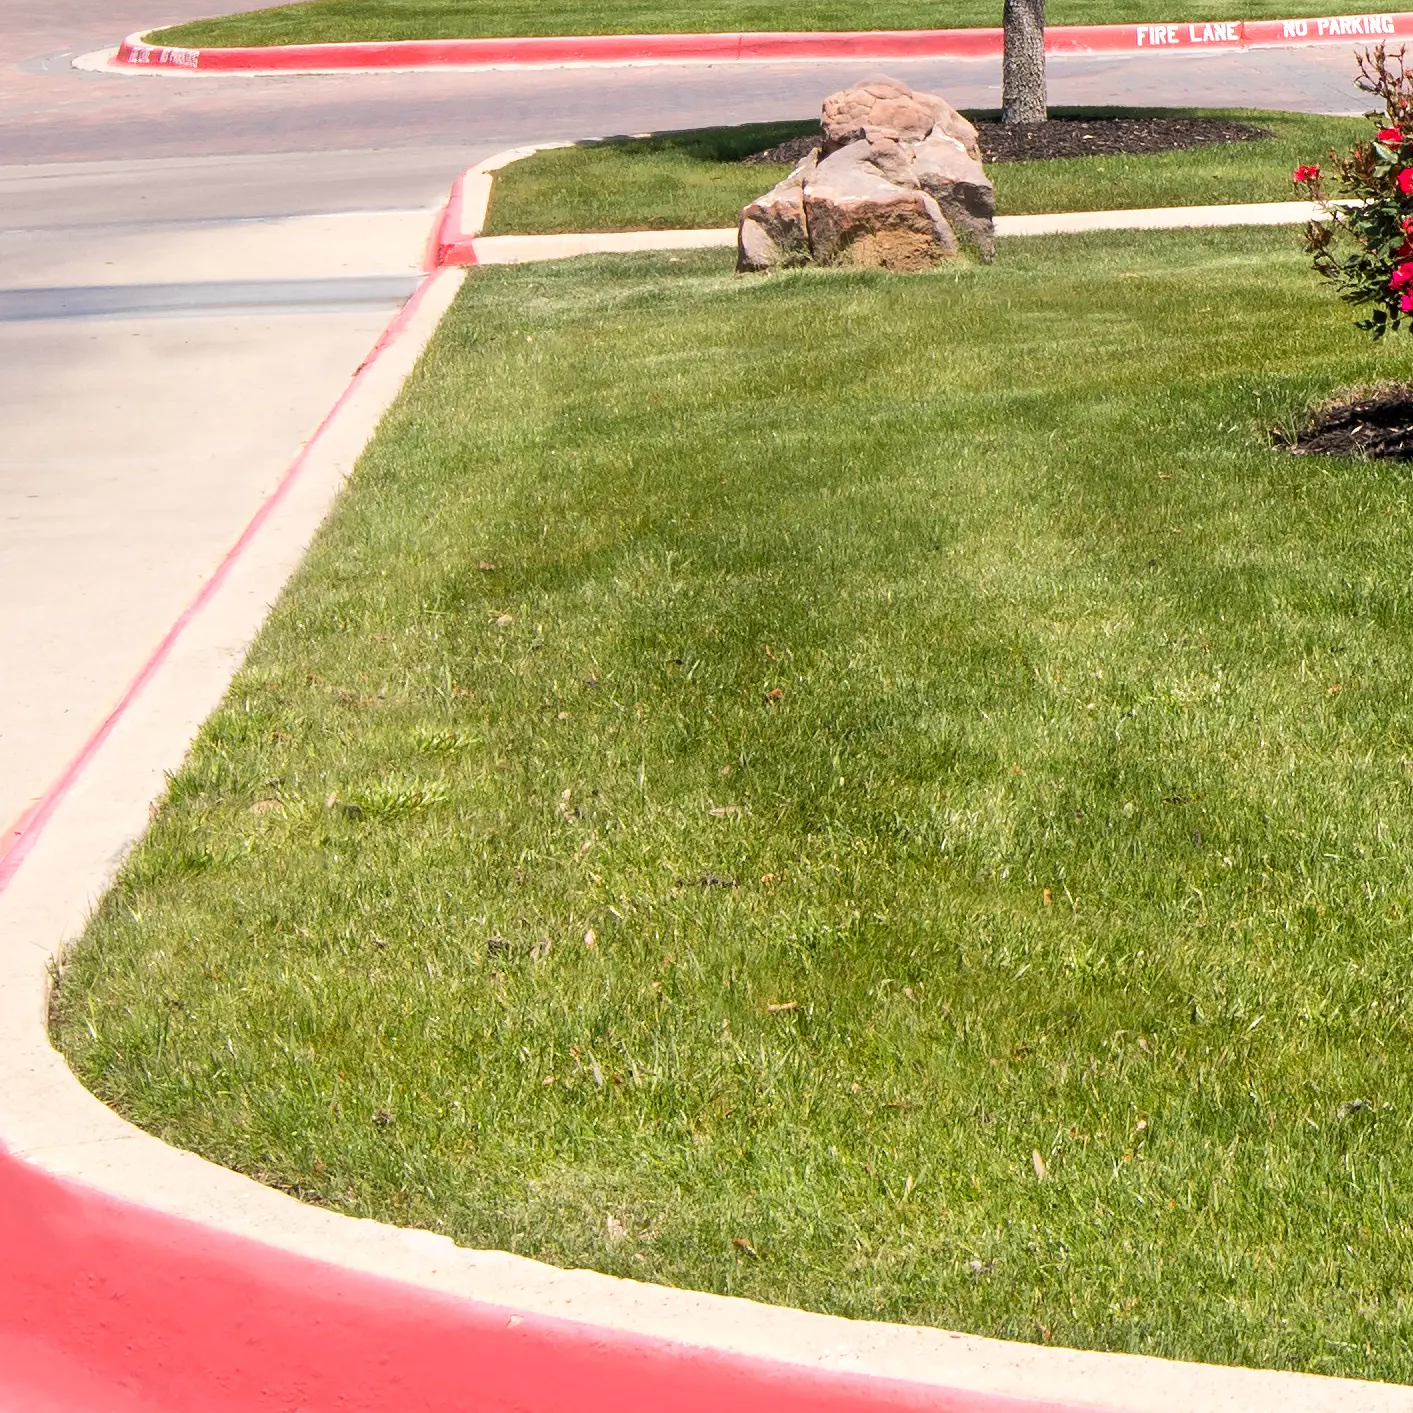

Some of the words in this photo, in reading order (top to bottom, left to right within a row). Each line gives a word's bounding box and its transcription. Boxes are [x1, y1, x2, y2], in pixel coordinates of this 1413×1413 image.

[1136, 25, 1179, 46] FIRE
[1188, 22, 1239, 42] LANE
[1282, 20, 1307, 37] NO
[1316, 15, 1395, 36] PARKING
